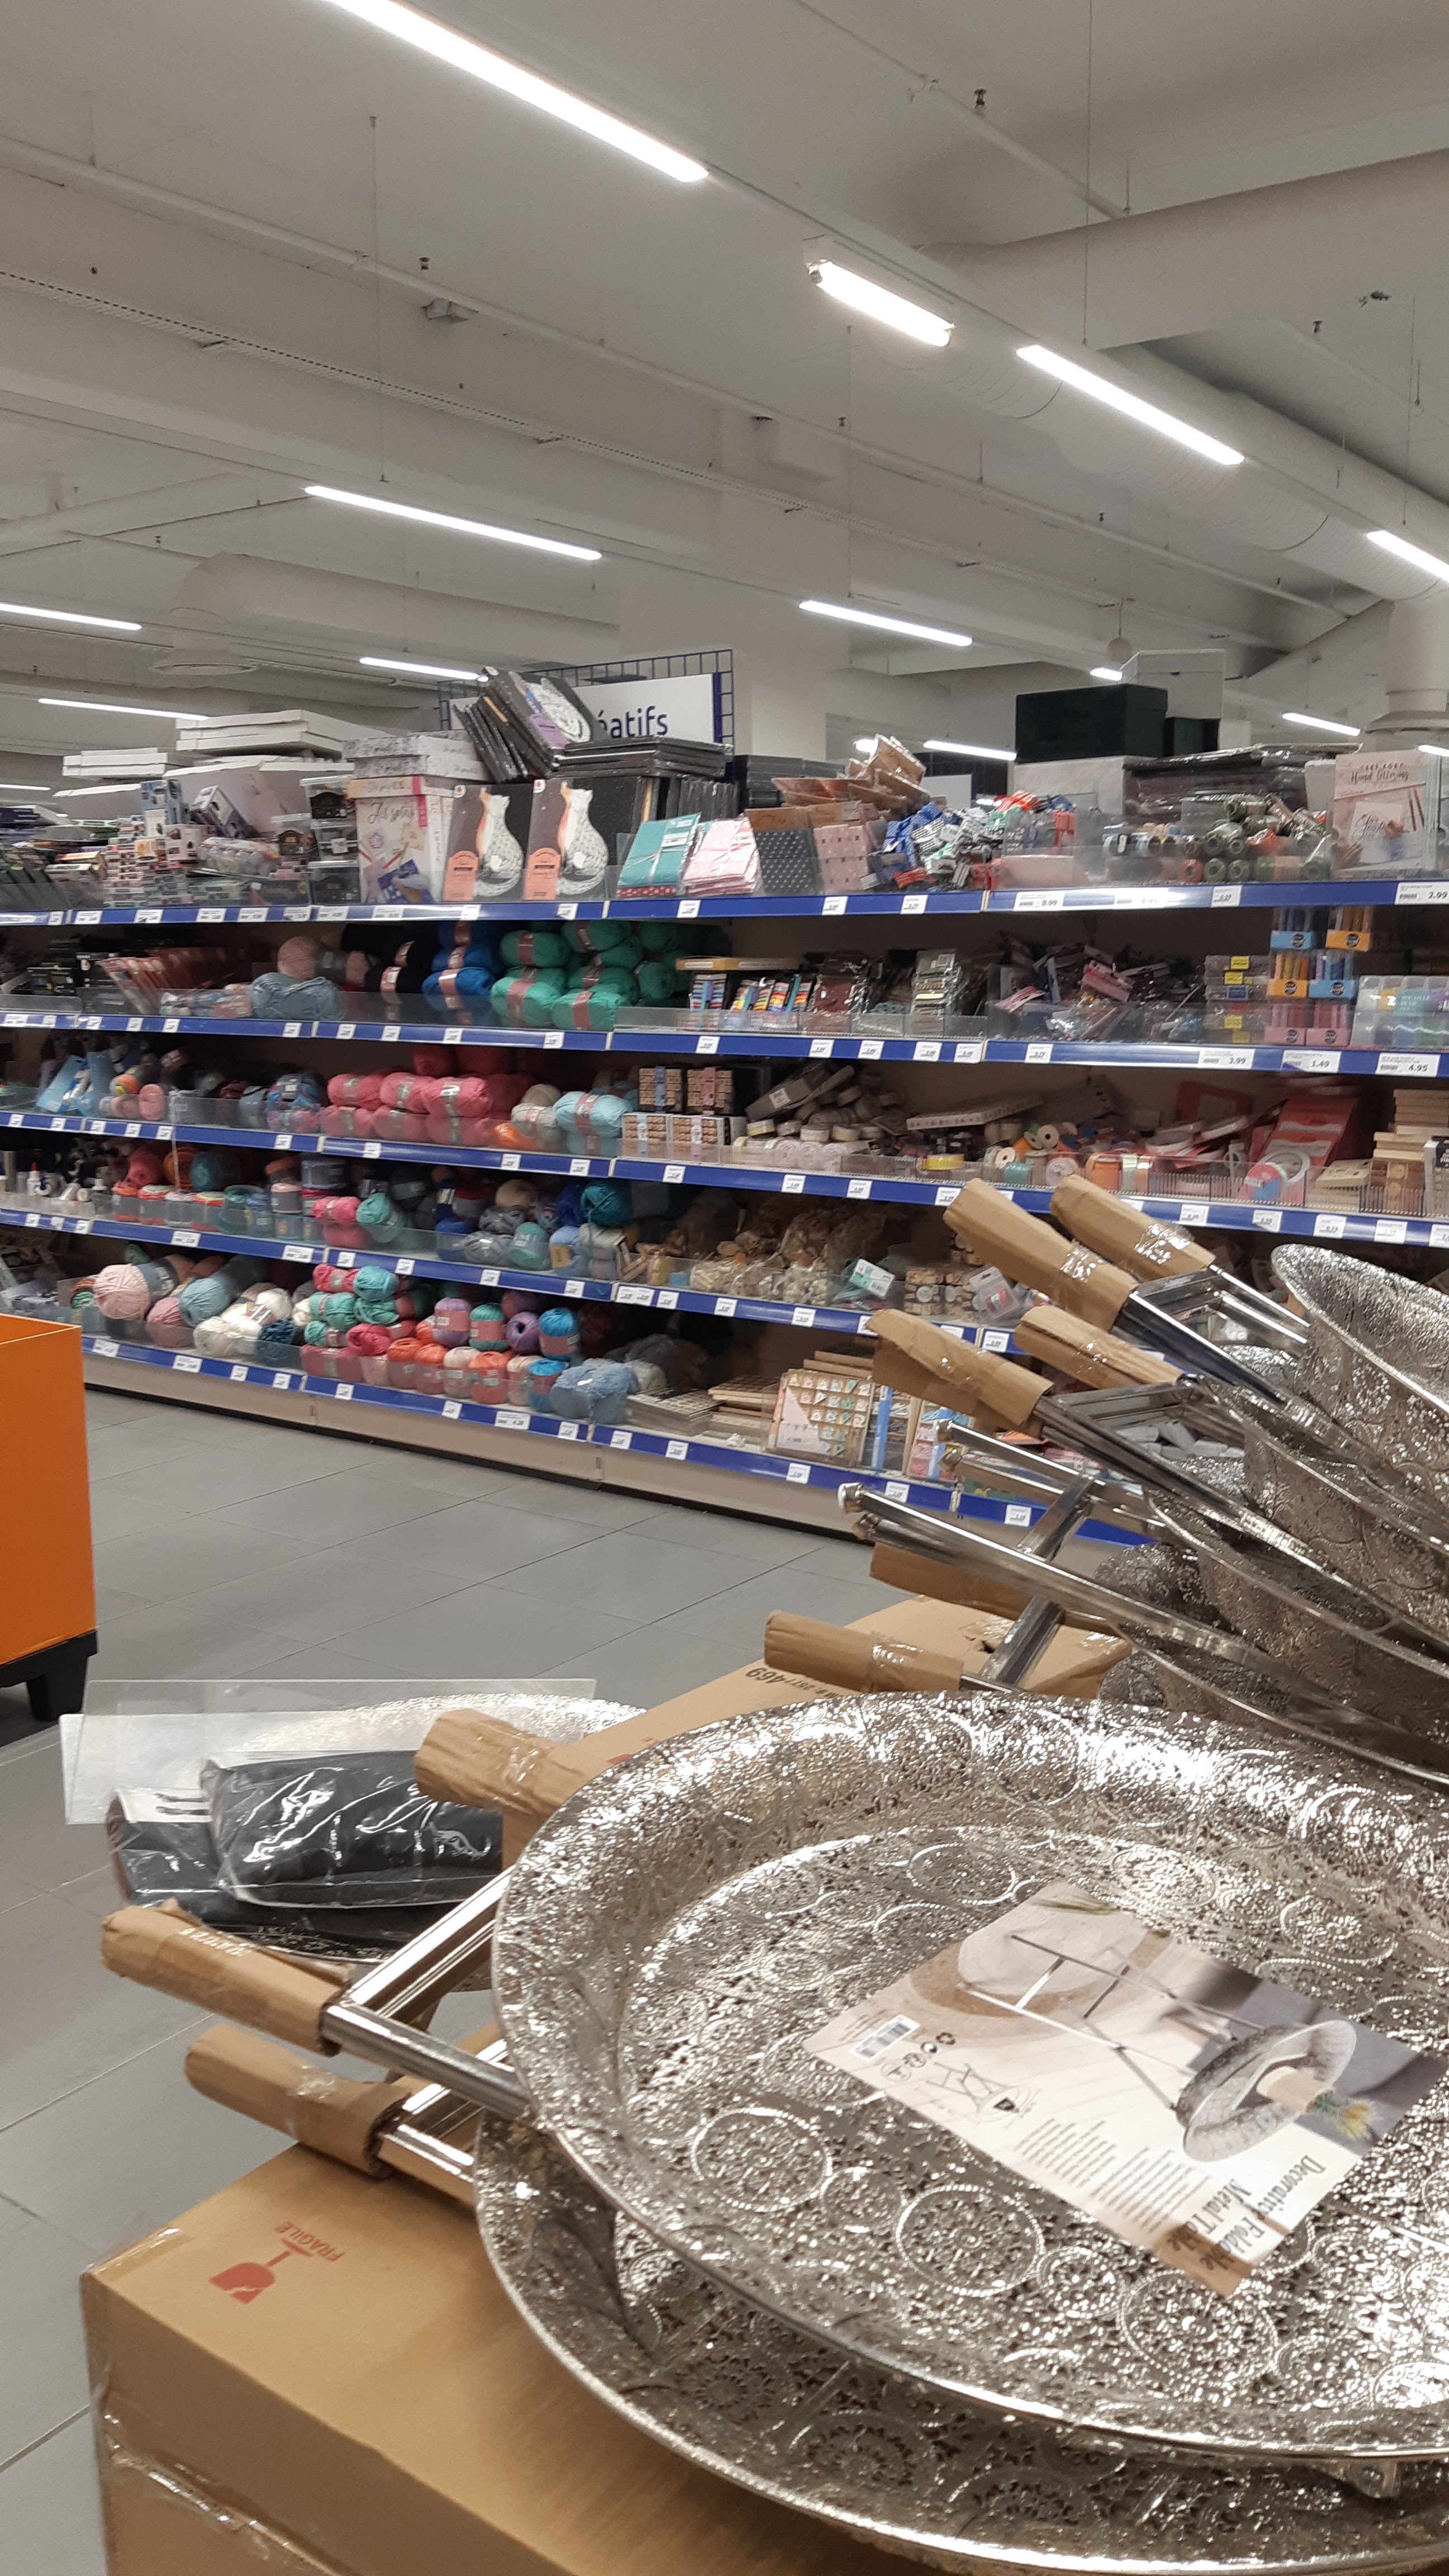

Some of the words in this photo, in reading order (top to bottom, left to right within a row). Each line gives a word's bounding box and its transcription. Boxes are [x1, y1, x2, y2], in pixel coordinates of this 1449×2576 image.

[1427, 891, 1448, 899] 2.99
[1310, 1059, 1330, 1068] 1.49
[1202, 2178, 1252, 2223] Metal
[1251, 2154, 1327, 2220] Decorative
[274, 2222, 345, 2262] FRAGILE
